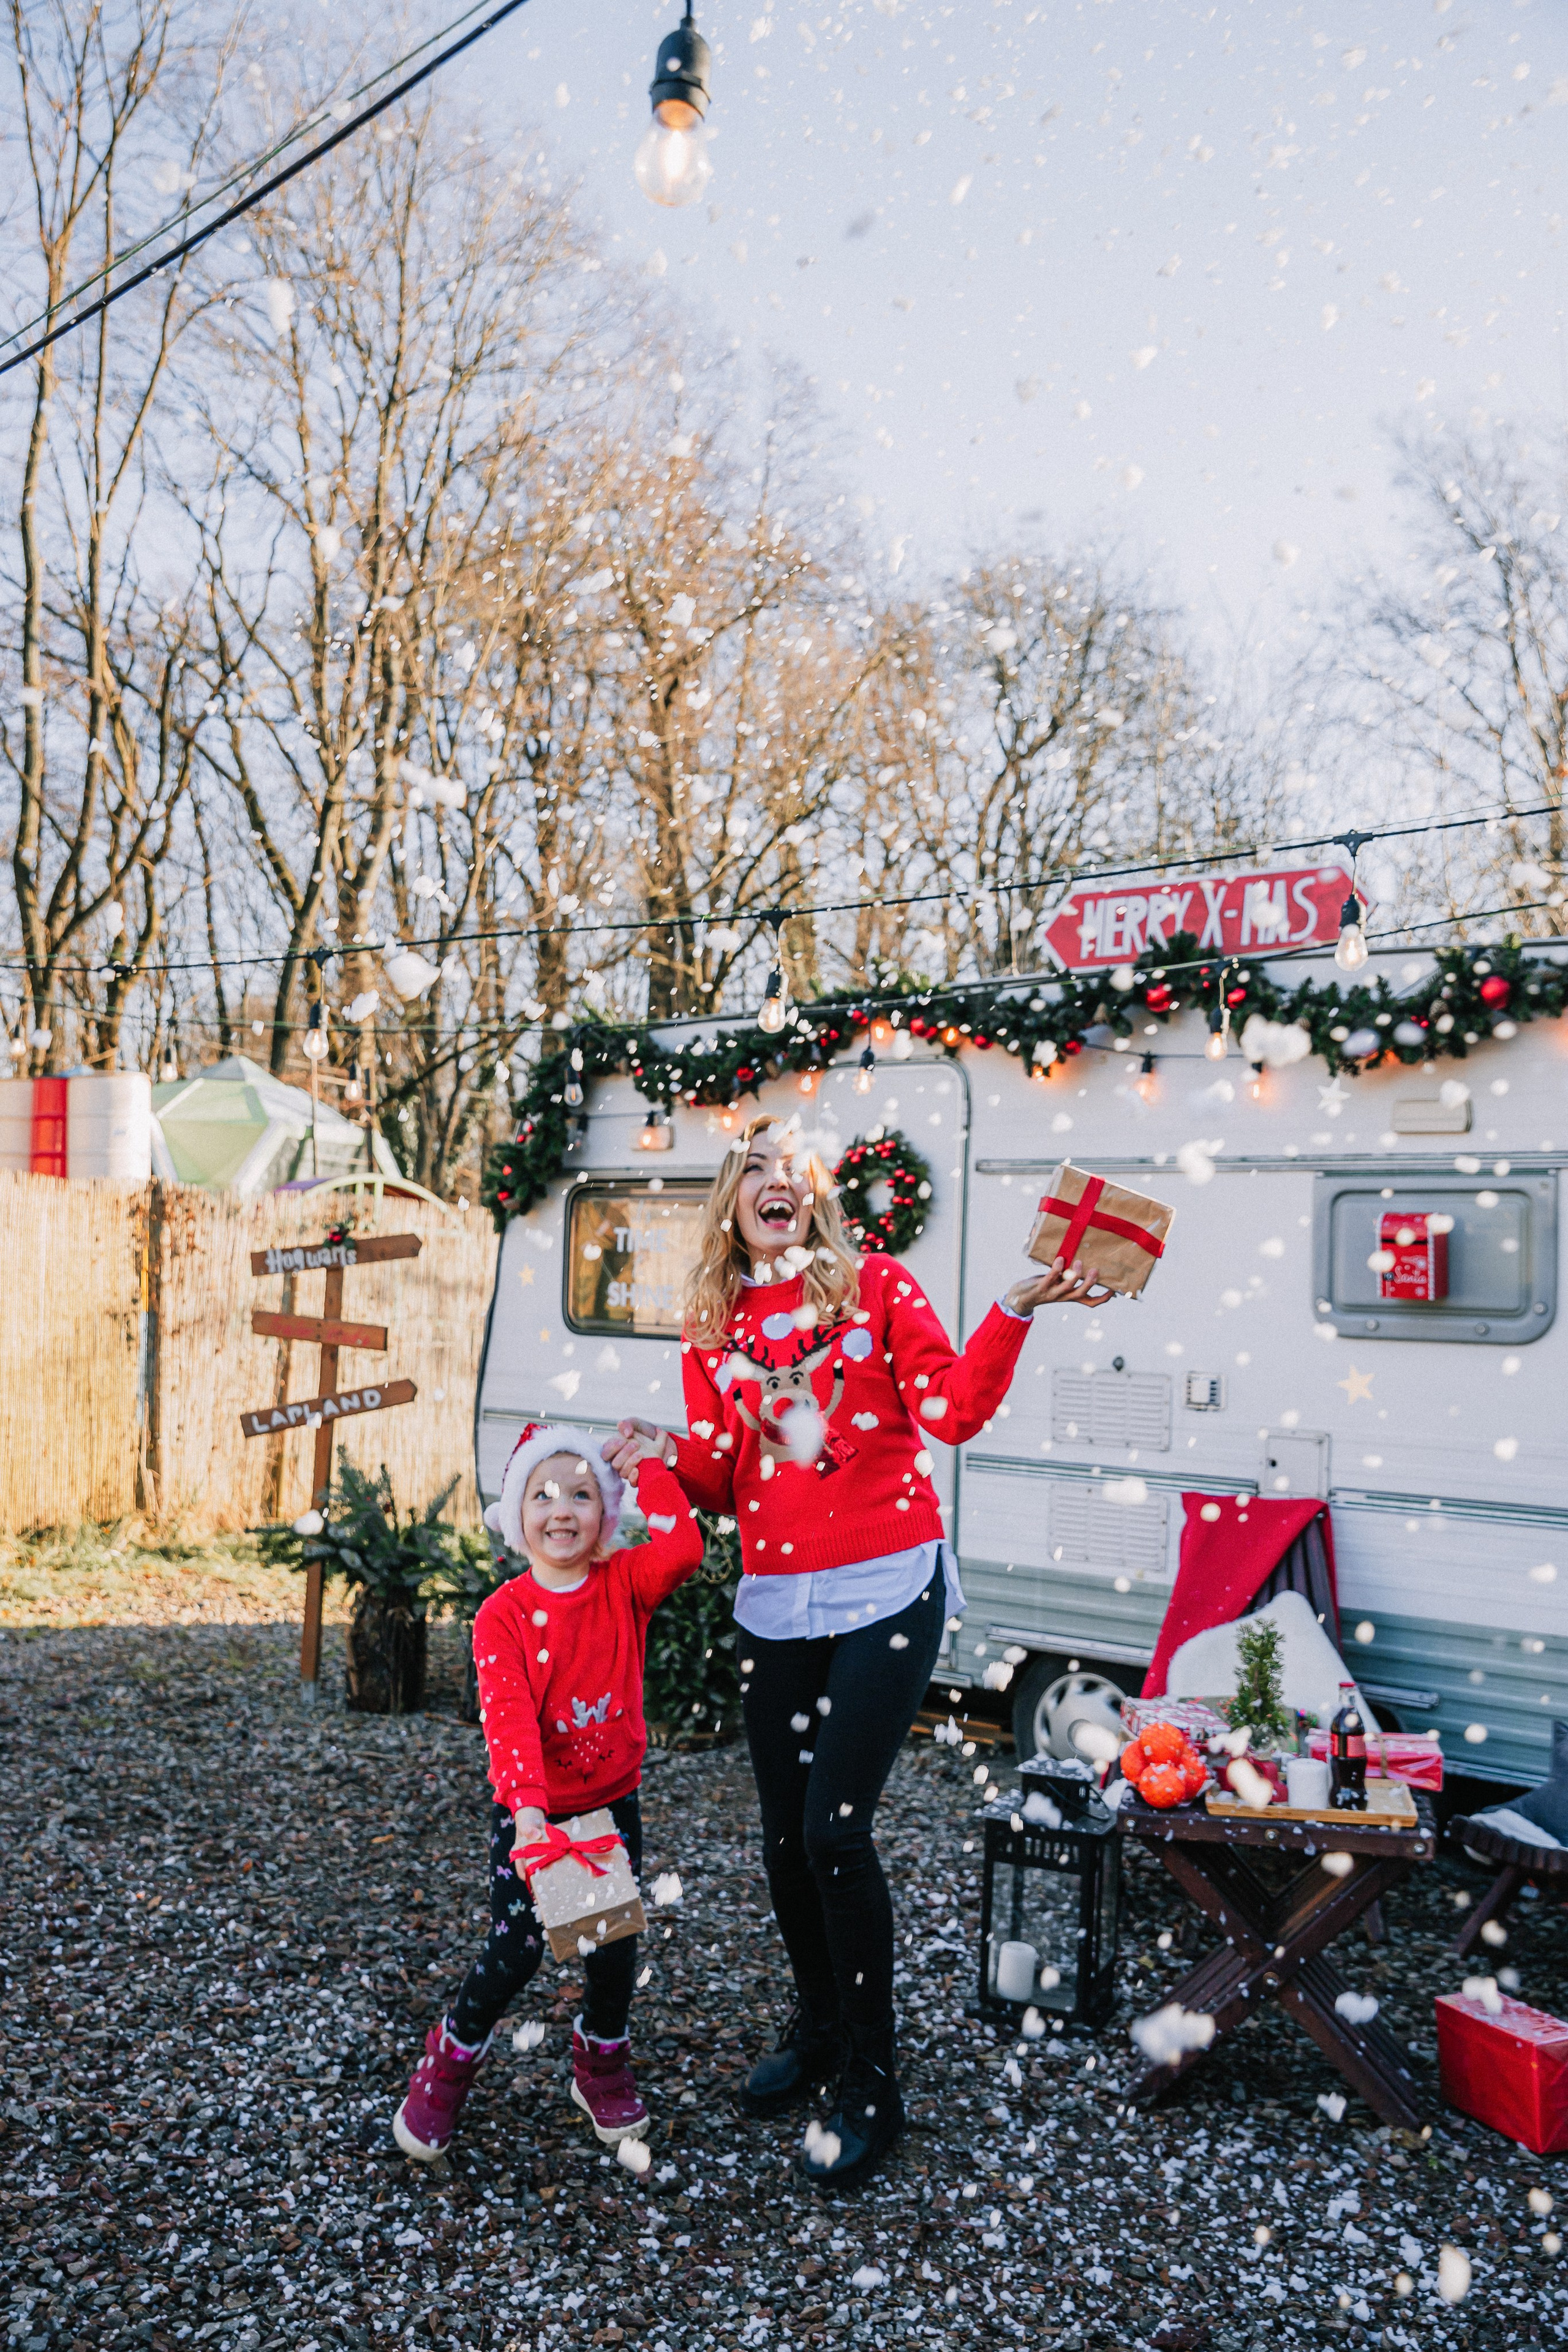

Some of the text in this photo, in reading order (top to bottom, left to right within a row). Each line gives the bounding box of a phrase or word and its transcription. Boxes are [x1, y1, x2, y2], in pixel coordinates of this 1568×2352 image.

[1079, 890, 1194, 960] MERRY
[613, 1226, 669, 1253] TIME
[606, 1281, 674, 1309] SHINE
[252, 1389, 381, 1433] LAPLAND
